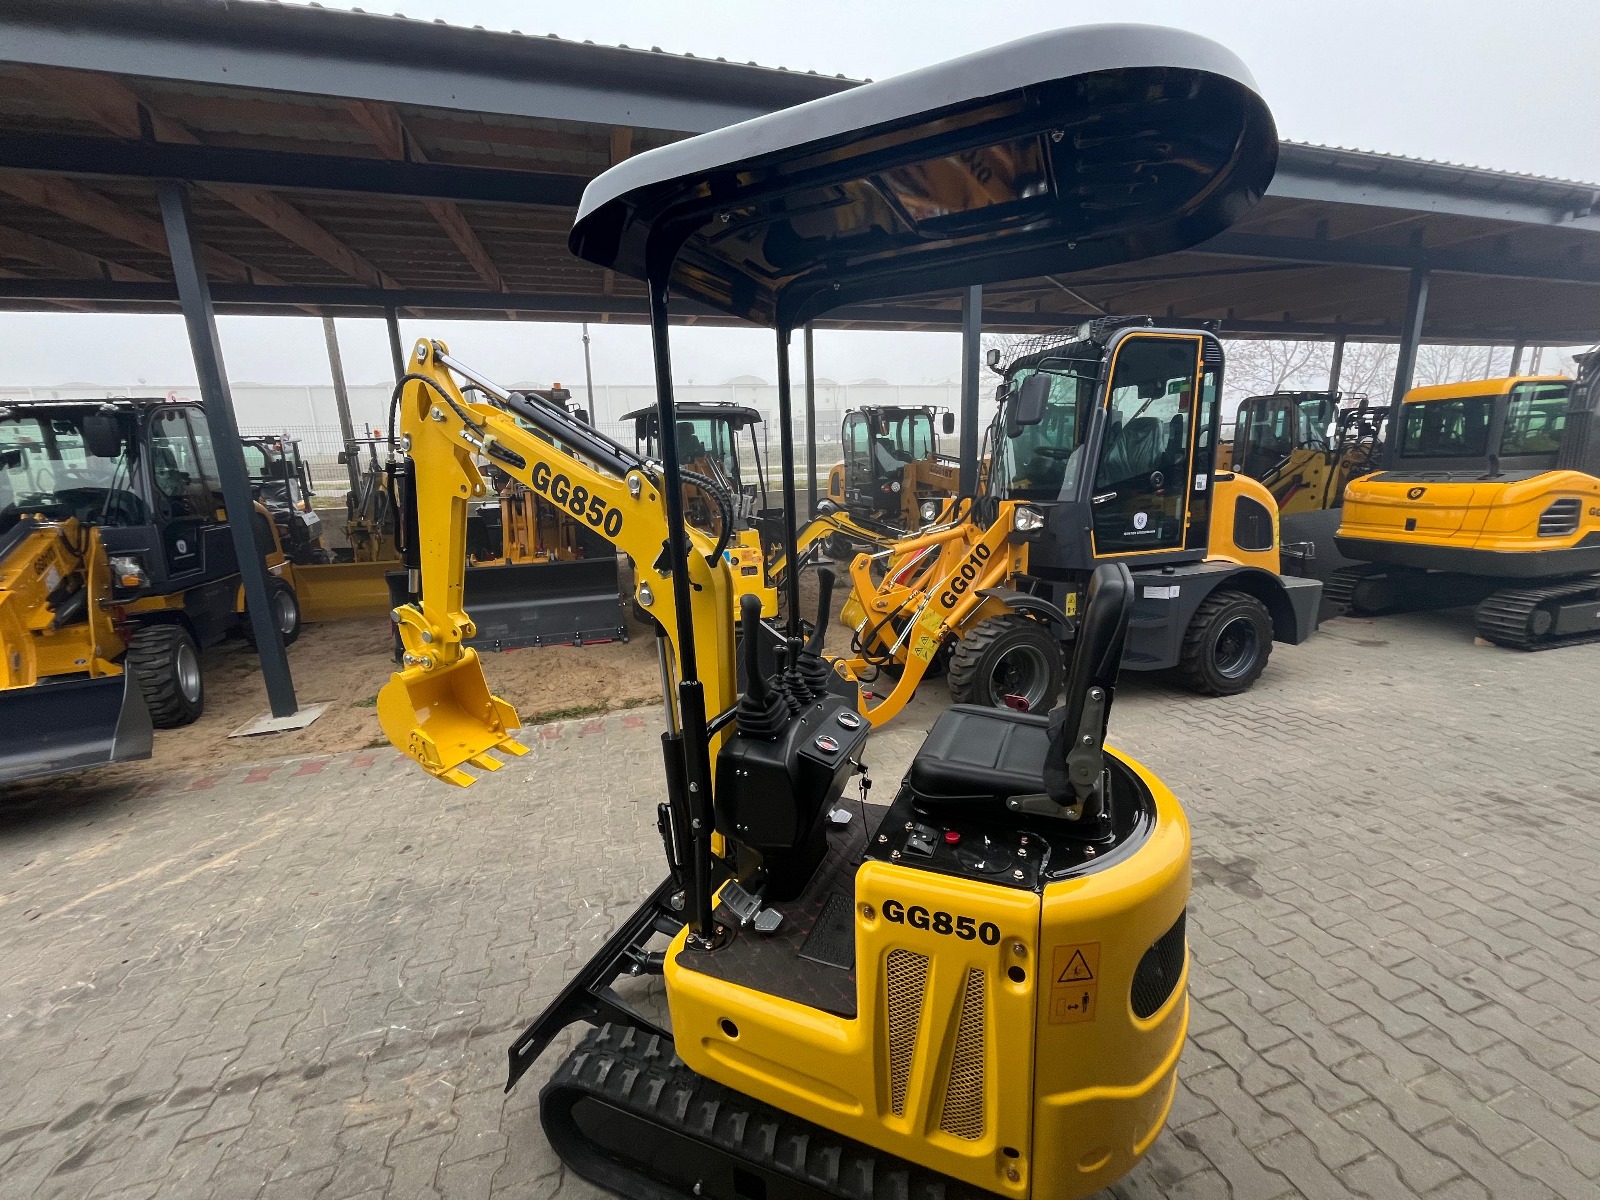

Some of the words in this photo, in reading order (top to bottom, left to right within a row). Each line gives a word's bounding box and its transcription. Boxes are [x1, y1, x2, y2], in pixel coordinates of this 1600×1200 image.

[532, 462, 622, 537] GG850
[941, 543, 990, 609] GG010
[882, 899, 1001, 946] GG850
